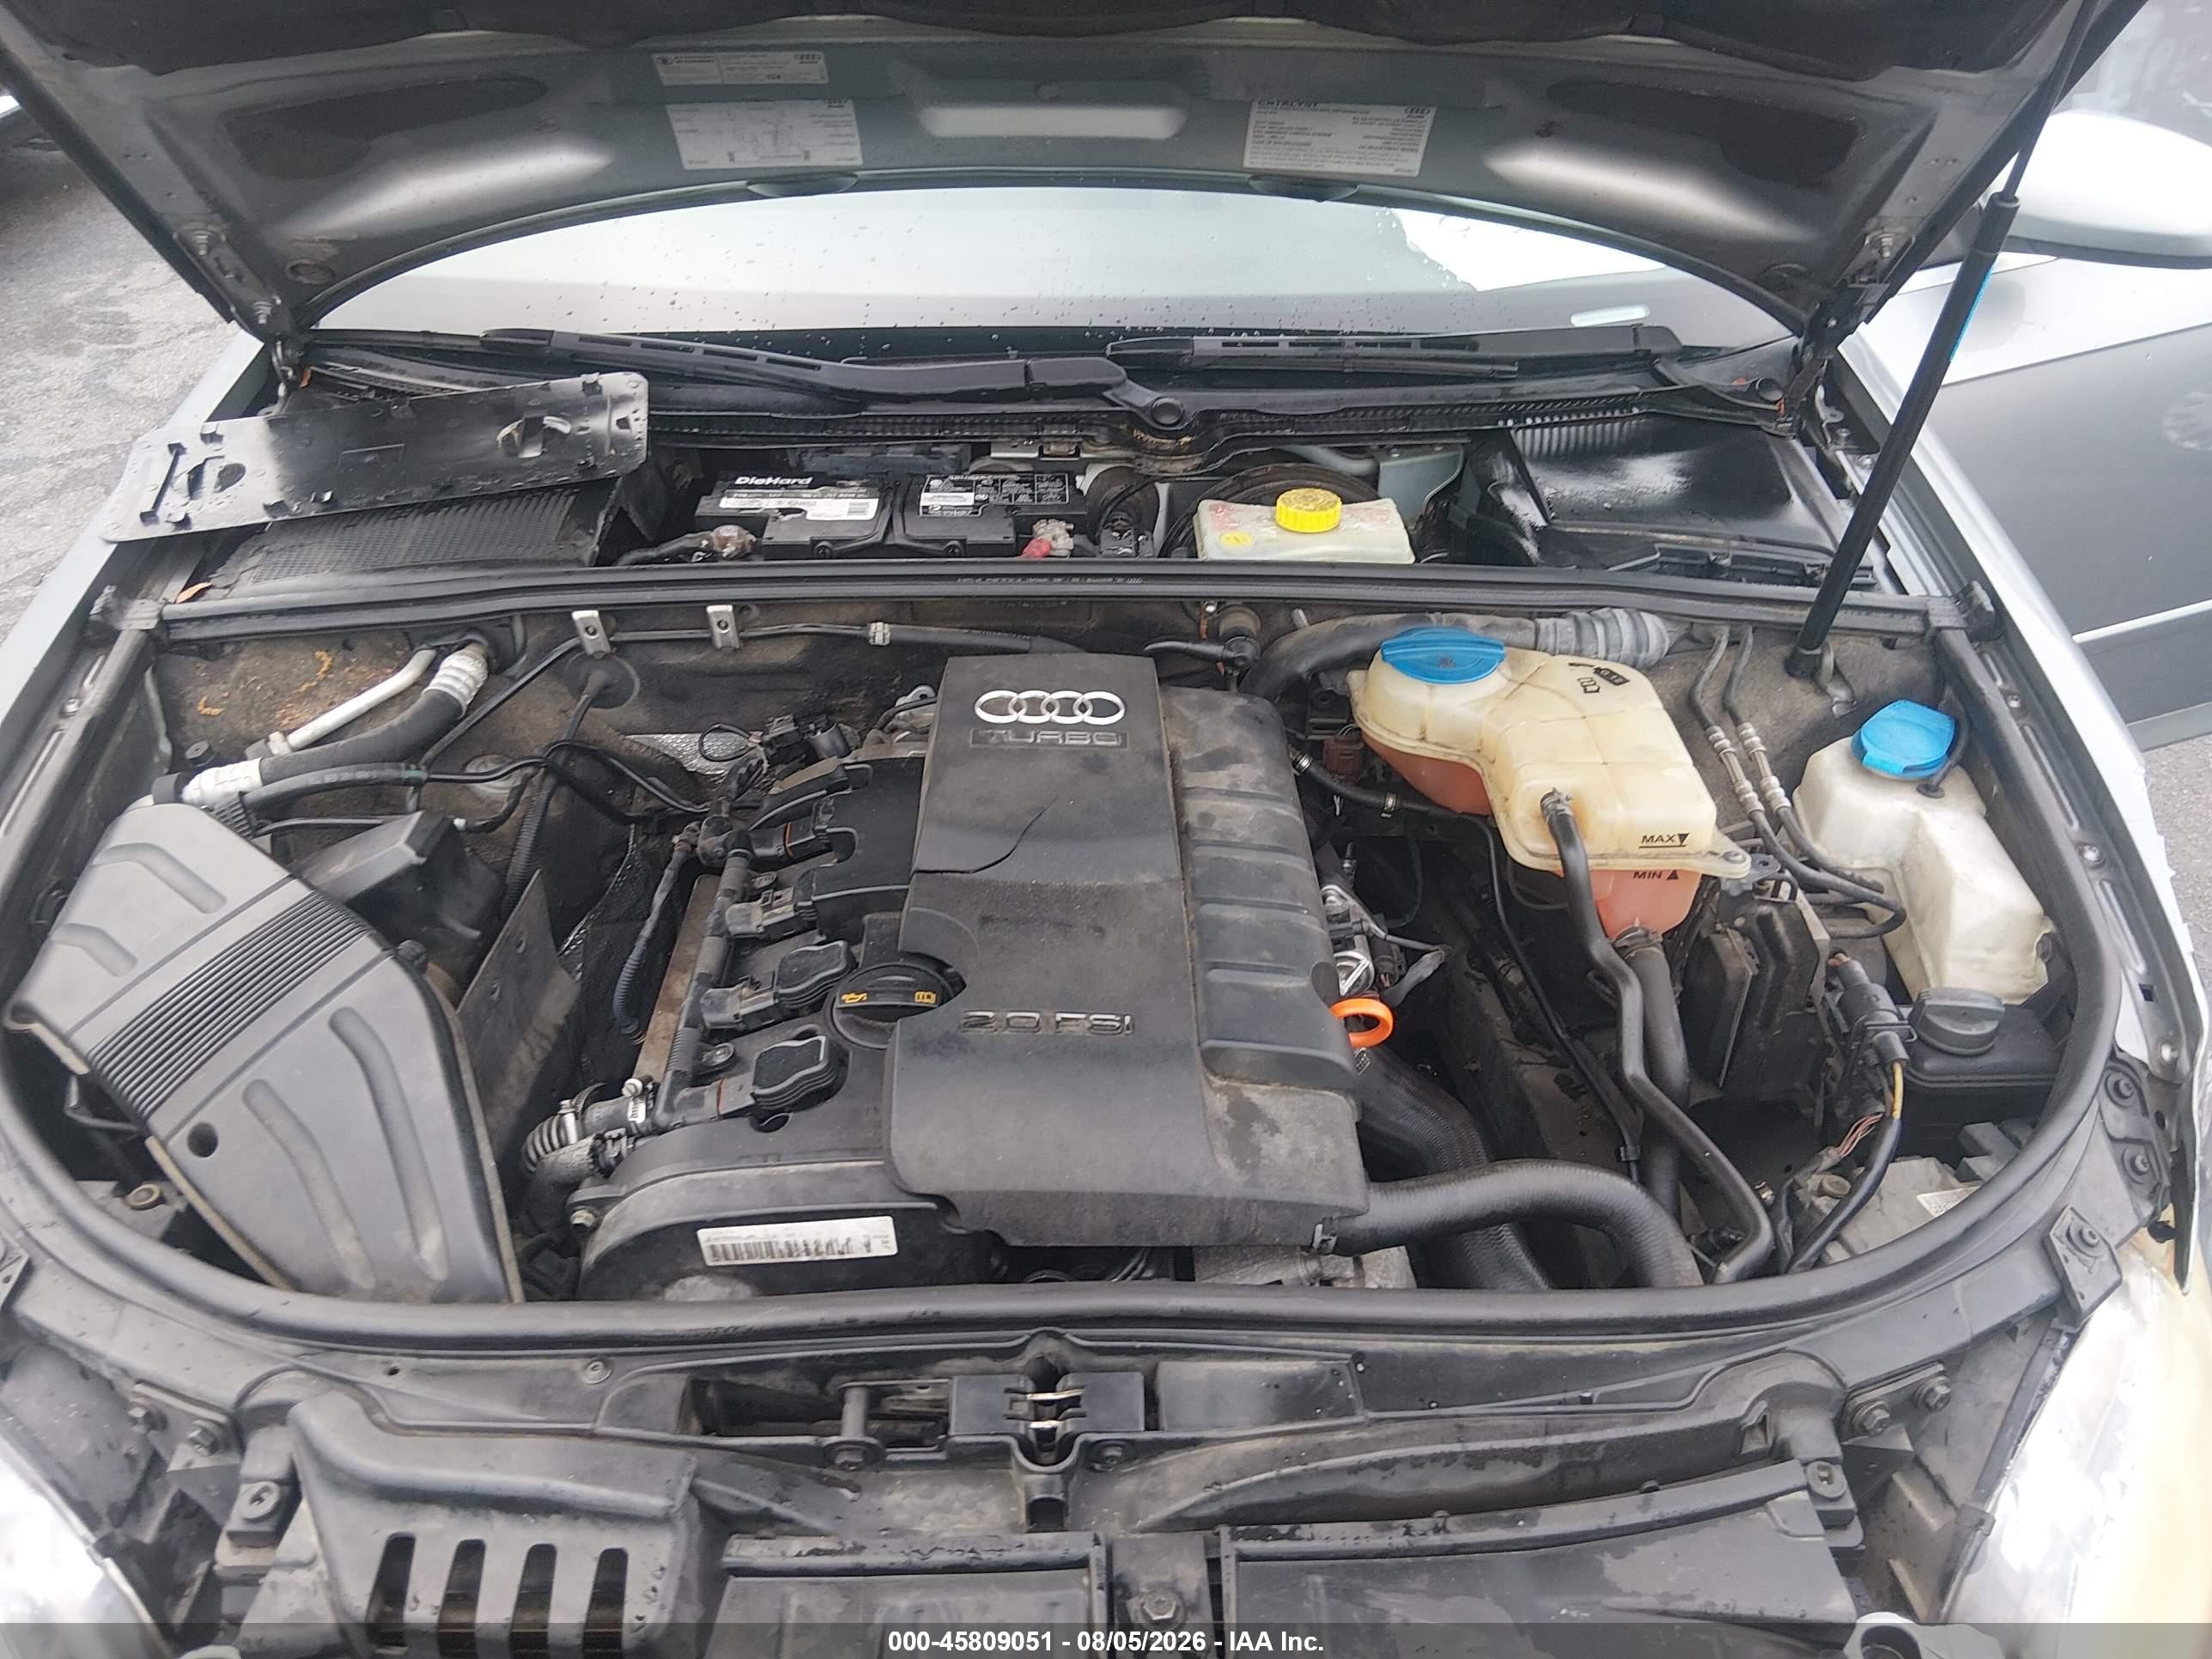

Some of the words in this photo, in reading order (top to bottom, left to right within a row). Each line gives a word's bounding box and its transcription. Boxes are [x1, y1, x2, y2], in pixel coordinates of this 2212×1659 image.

[734, 476, 814, 486] DieHard
[981, 729, 1122, 746] TURBO
[1641, 834, 1676, 844] MAX
[1633, 871, 1662, 880] MIN
[1054, 1011, 1135, 1036] FSI
